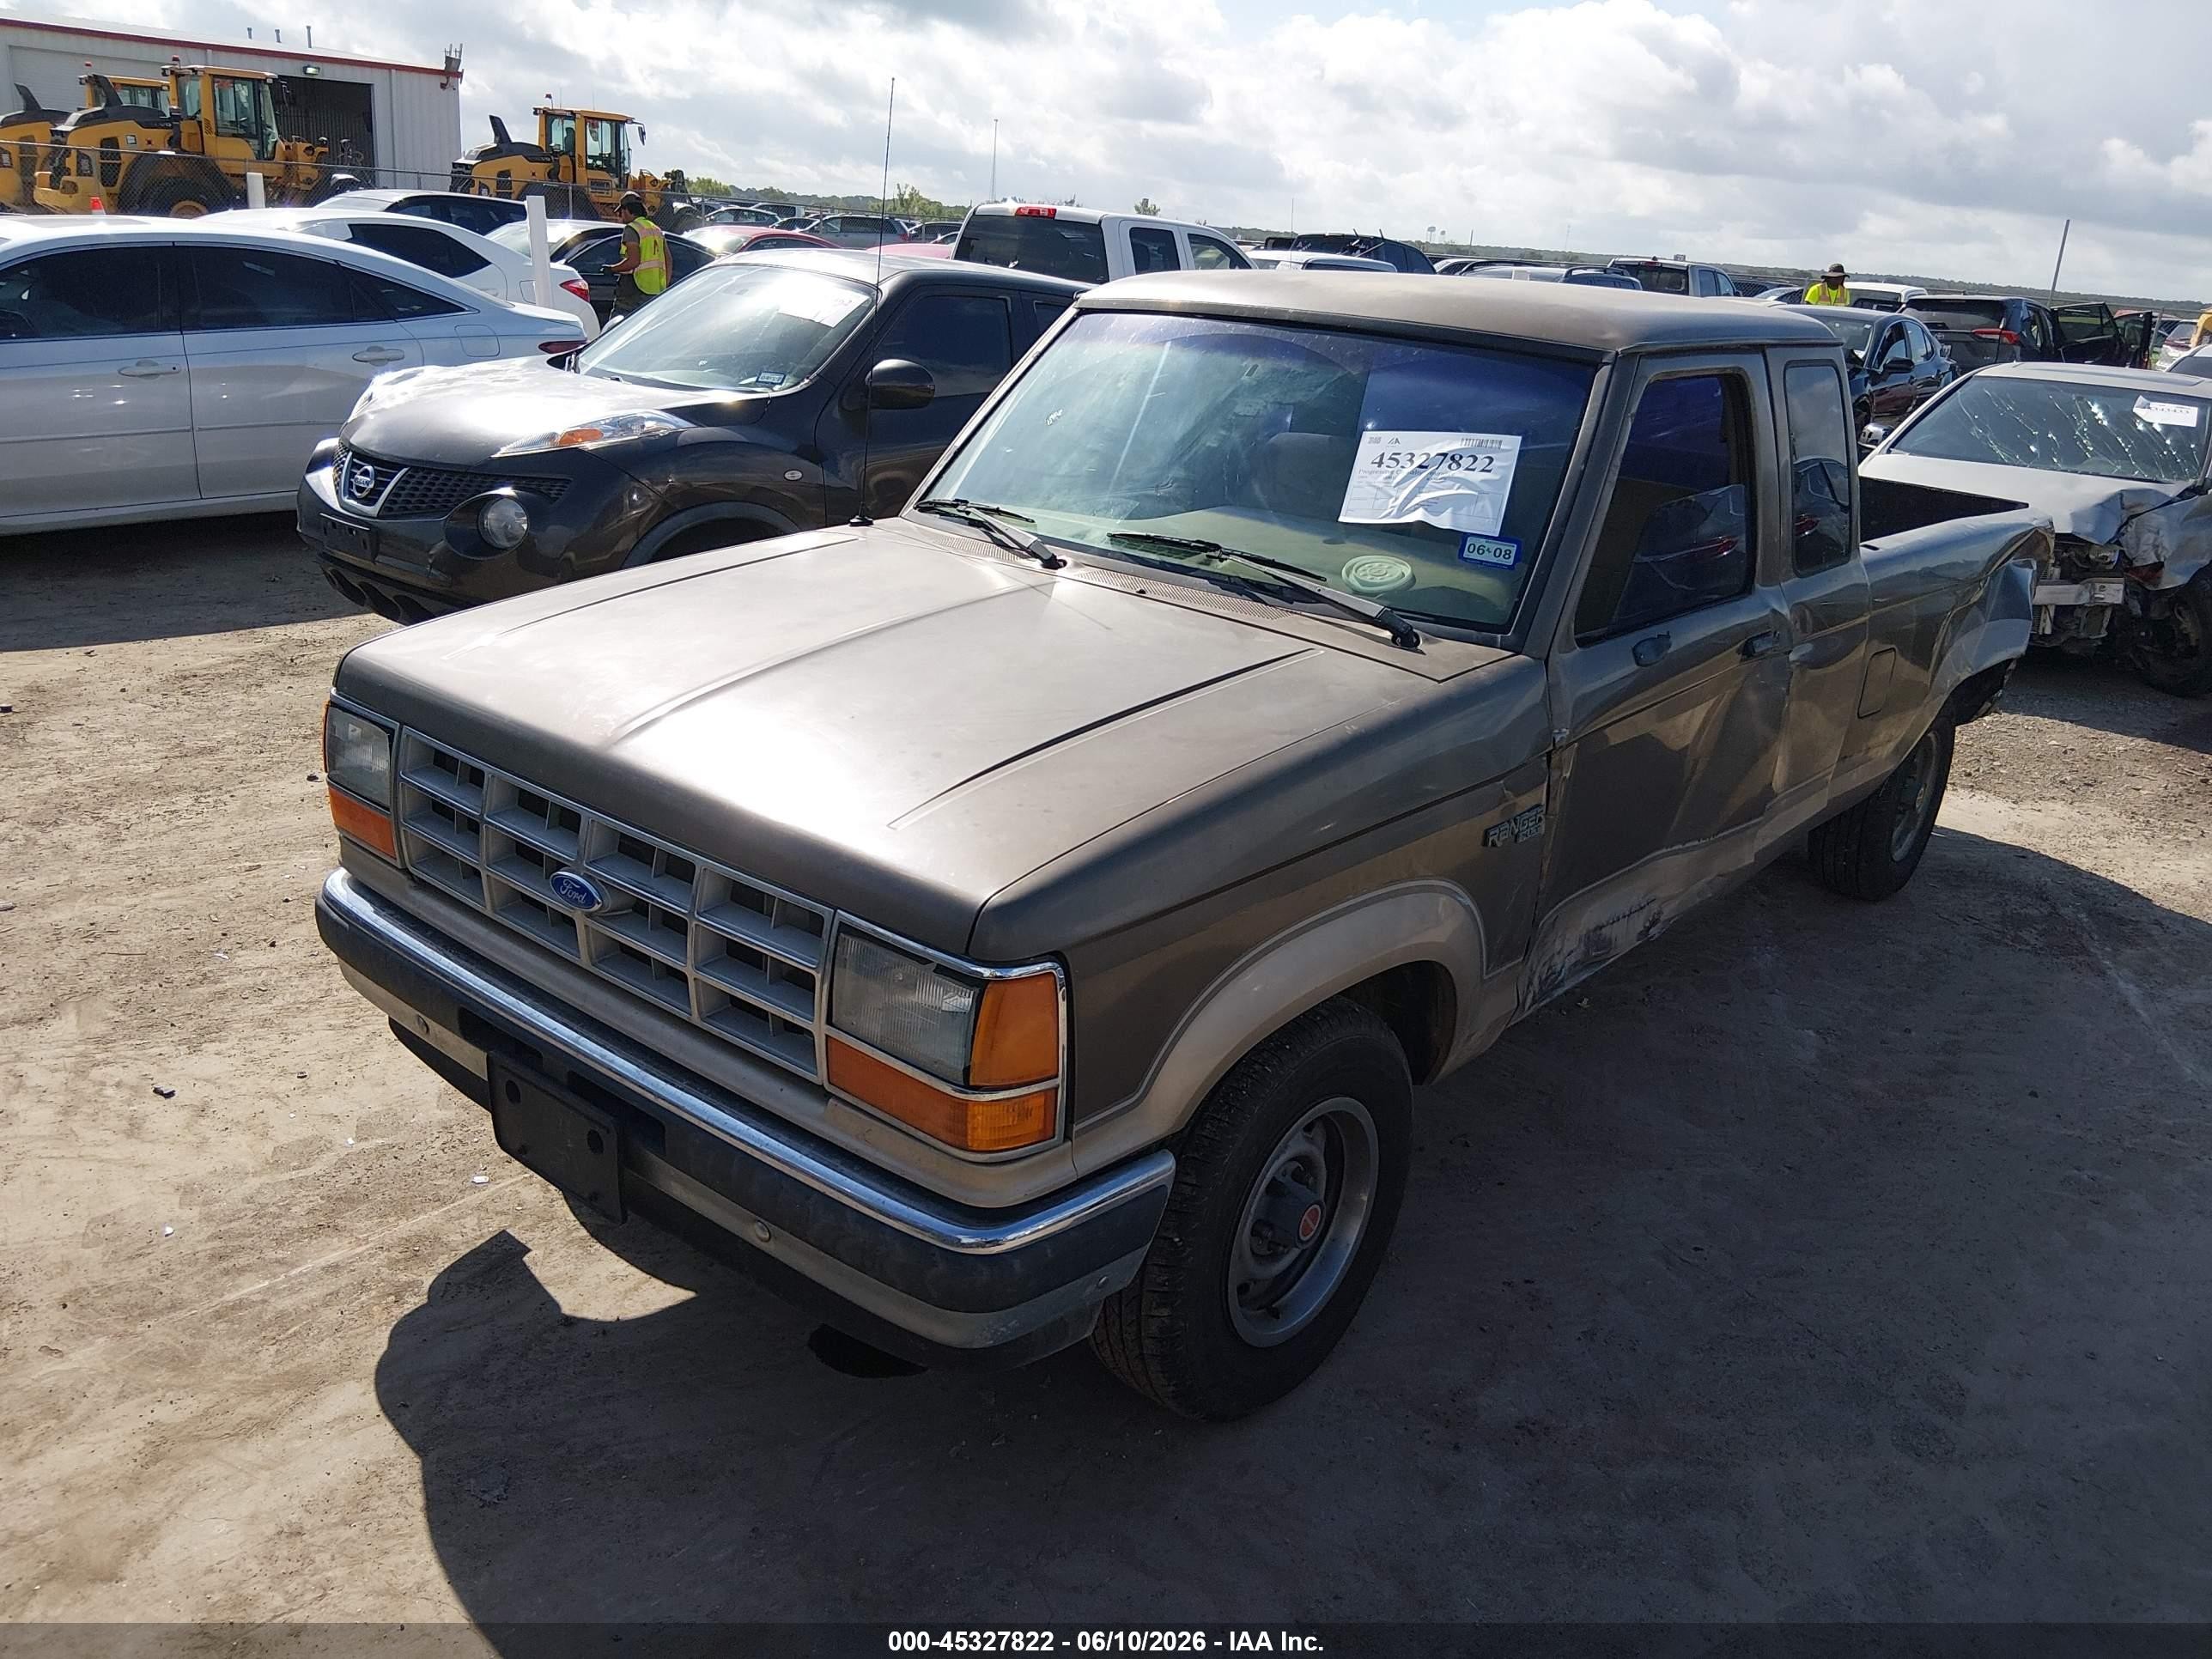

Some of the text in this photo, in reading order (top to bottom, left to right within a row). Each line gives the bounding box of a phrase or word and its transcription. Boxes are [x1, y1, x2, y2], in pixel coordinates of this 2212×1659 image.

[1371, 452, 1495, 473] 45327822
[1467, 543, 1486, 556] 06
[1492, 547, 1512, 560] 08
[559, 878, 586, 904] Ford
